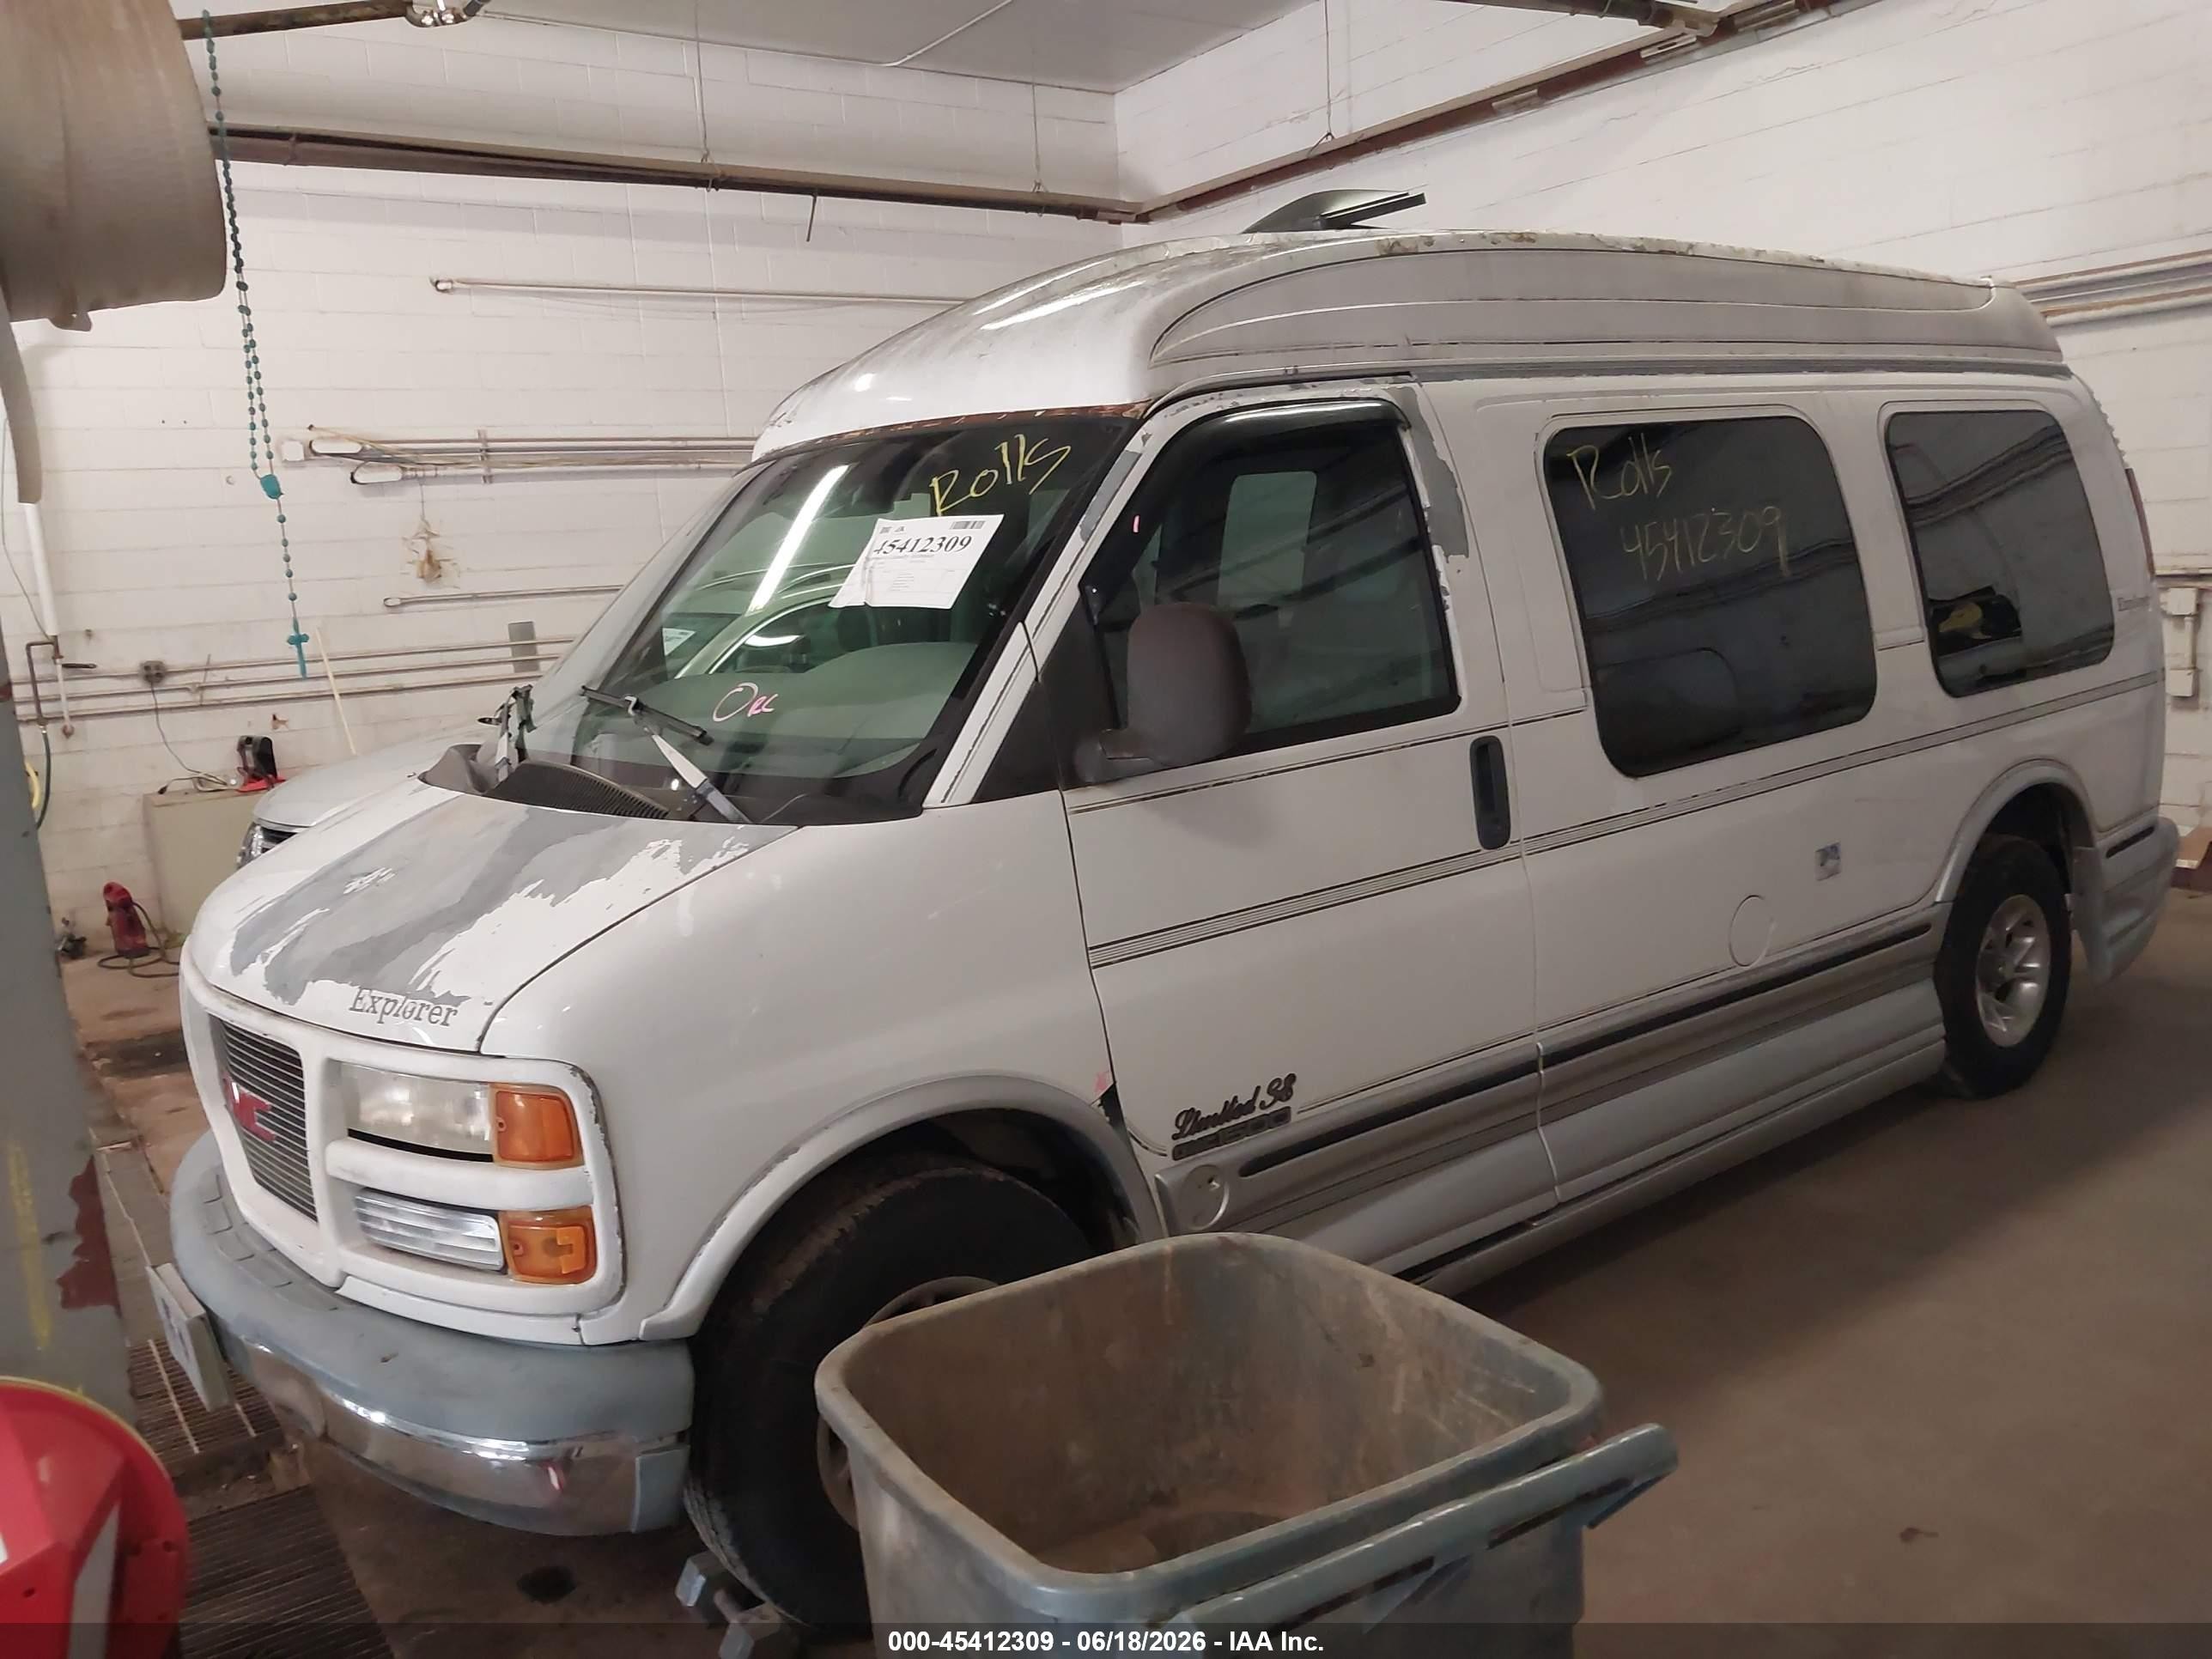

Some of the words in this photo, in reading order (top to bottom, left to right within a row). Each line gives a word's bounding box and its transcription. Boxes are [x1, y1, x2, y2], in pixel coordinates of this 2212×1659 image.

[929, 434, 1071, 517] Rolls
[1567, 432, 1672, 510] Rolls
[873, 535, 973, 555] 45412309
[1620, 505, 1790, 580] 45412309
[349, 988, 459, 1026] Explorer
